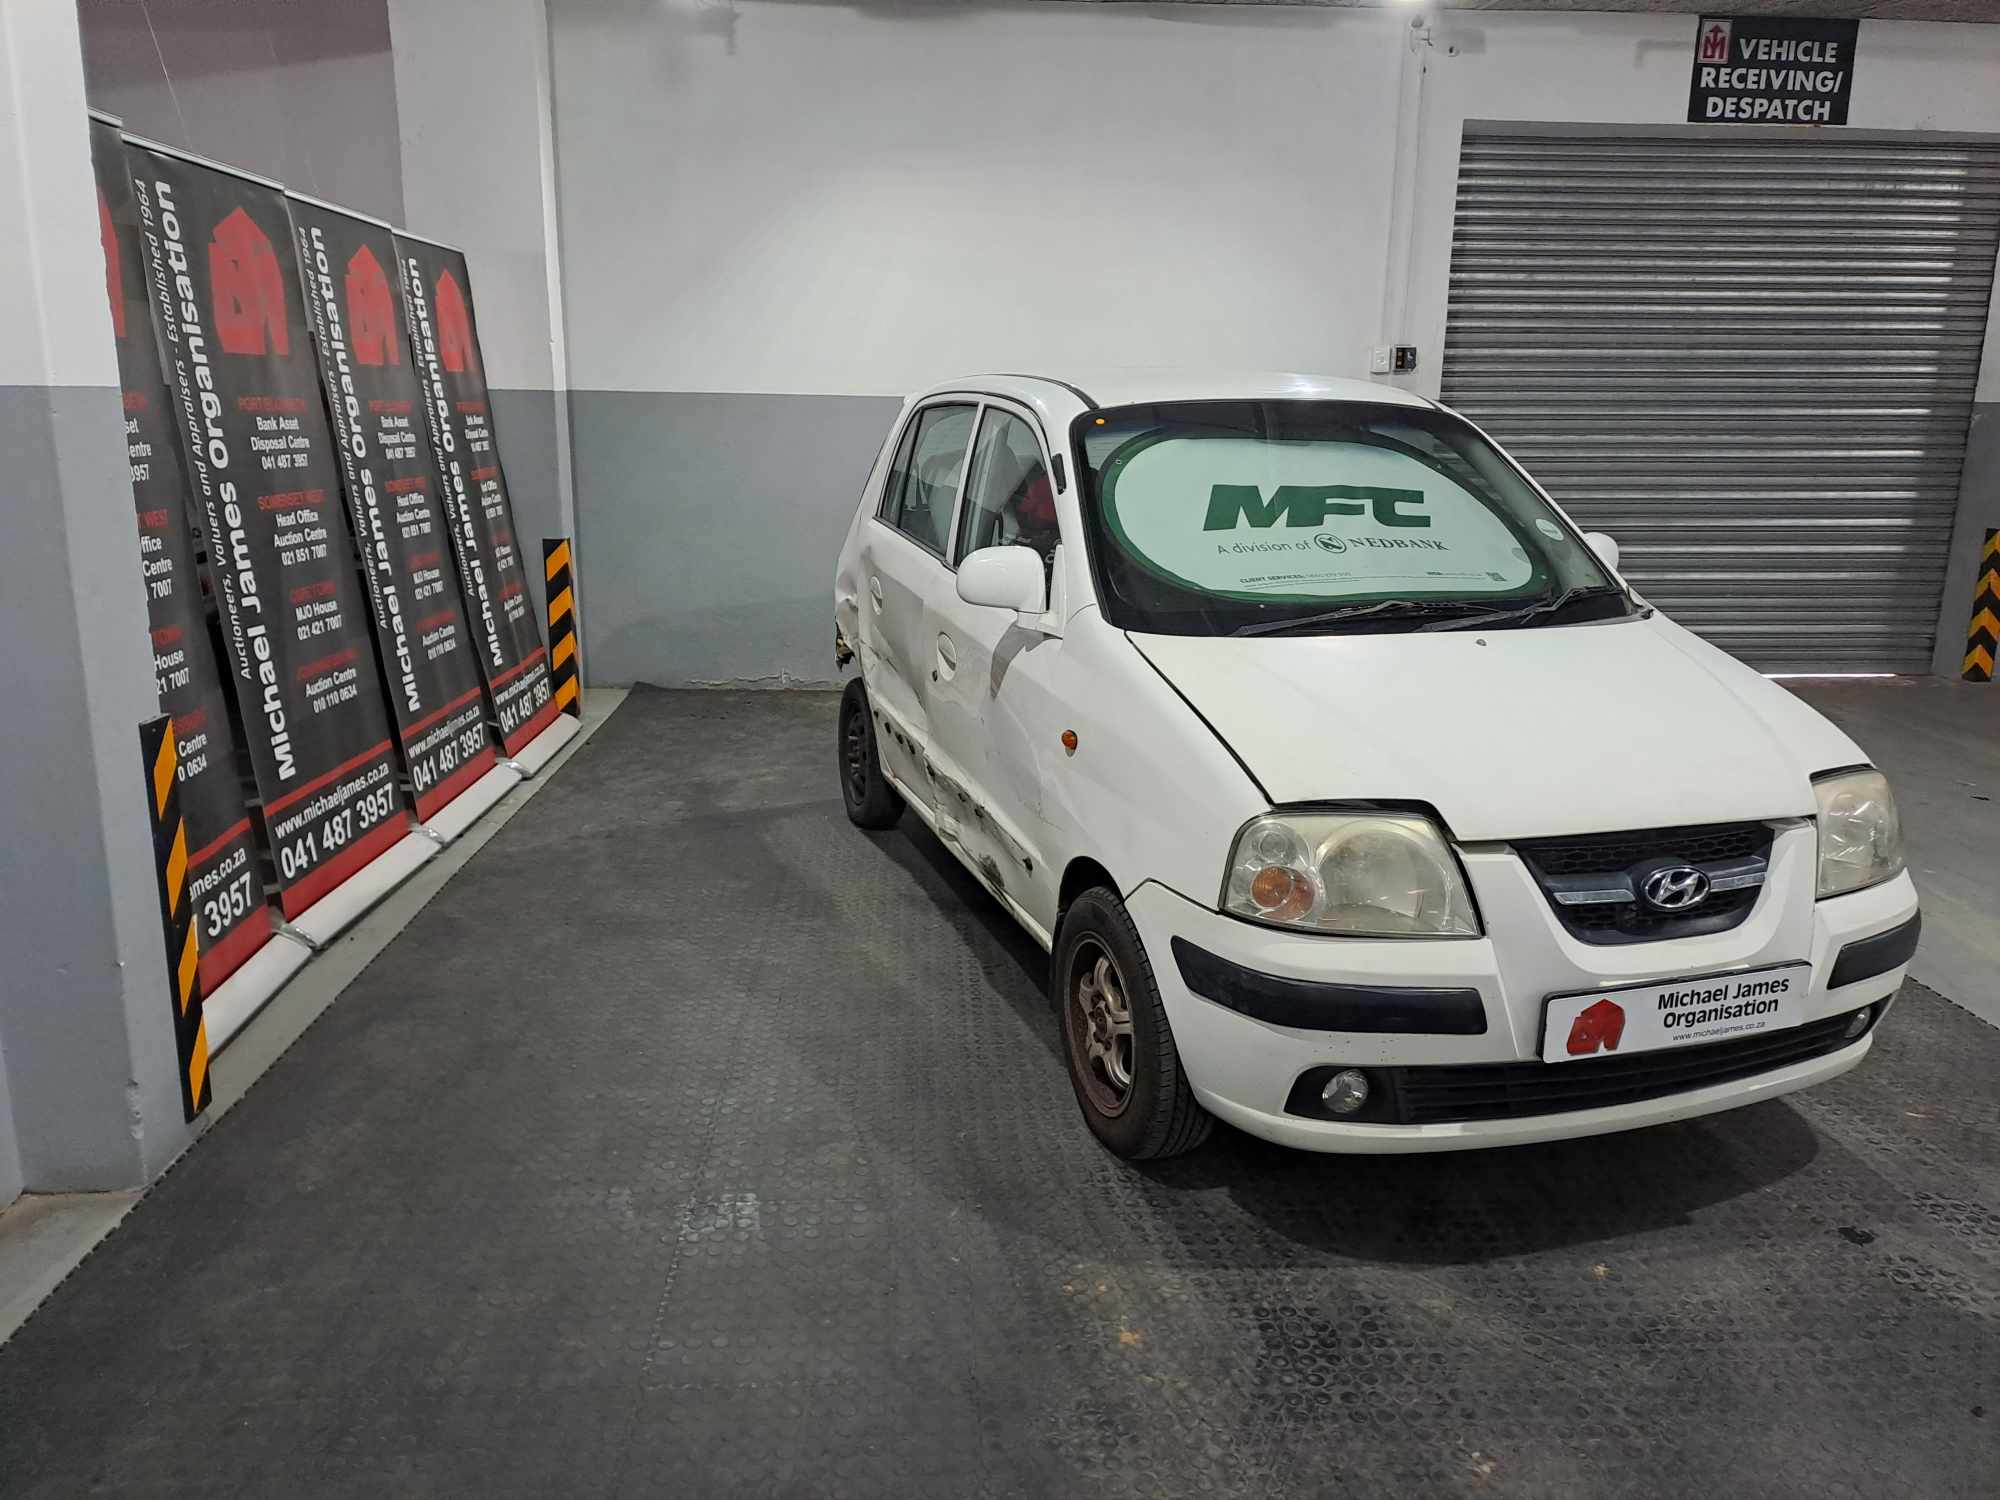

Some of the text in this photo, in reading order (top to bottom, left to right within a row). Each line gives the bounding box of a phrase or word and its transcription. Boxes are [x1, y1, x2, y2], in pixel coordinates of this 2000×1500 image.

[1739, 38, 1838, 63] VEHICLE
[1700, 67, 1843, 93] RECEIVING/
[1706, 97, 1831, 121] DESPATCH
[134, 179, 157, 228] 1964
[298, 227, 314, 265] 1964
[150, 236, 179, 343] Established
[305, 267, 330, 356] Established
[310, 227, 368, 459] Organisation
[408, 257, 454, 453] Organisation
[175, 359, 204, 457] Appraisers
[256, 416, 278, 431] Bank
[327, 371, 350, 448] Appraisers
[129, 441, 152, 458] entre
[250, 436, 288, 452] Disposal
[155, 180, 297, 781] Michael James Organisation
[192, 460, 212, 496] and
[261, 456, 276, 471] 041
[342, 451, 356, 480] and
[361, 468, 393, 577] James
[450, 461, 478, 552] James
[1202, 483, 1432, 532] MFC
[140, 535, 163, 554] ffice
[206, 501, 227, 566] Valuers
[274, 531, 304, 548] Auction
[1217, 535, 1449, 556] A division of NEDBANK
[142, 557, 174, 577] Centre
[150, 578, 173, 600] 7007
[222, 574, 253, 680] Auctioneers,
[469, 560, 503, 667] Michael
[382, 585, 421, 713] Michael
[169, 667, 190, 690] 7007
[305, 675, 334, 698] Auction
[499, 677, 551, 733] 041 487 3957
[178, 733, 208, 758] Centre
[413, 722, 485, 792] 041 487 3957
[187, 755, 208, 779] 0634
[275, 761, 389, 840] www.michaeljames.co.za
[280, 834, 318, 880] 041
[322, 809, 353, 852] 487
[356, 782, 395, 830] 3957
[203, 870, 253, 938] 3957
[1657, 977, 1790, 1010] Michael James
[1663, 998, 1779, 1029] Organisation
[1672, 1021, 1766, 1041] www.michaeljames.co.za
